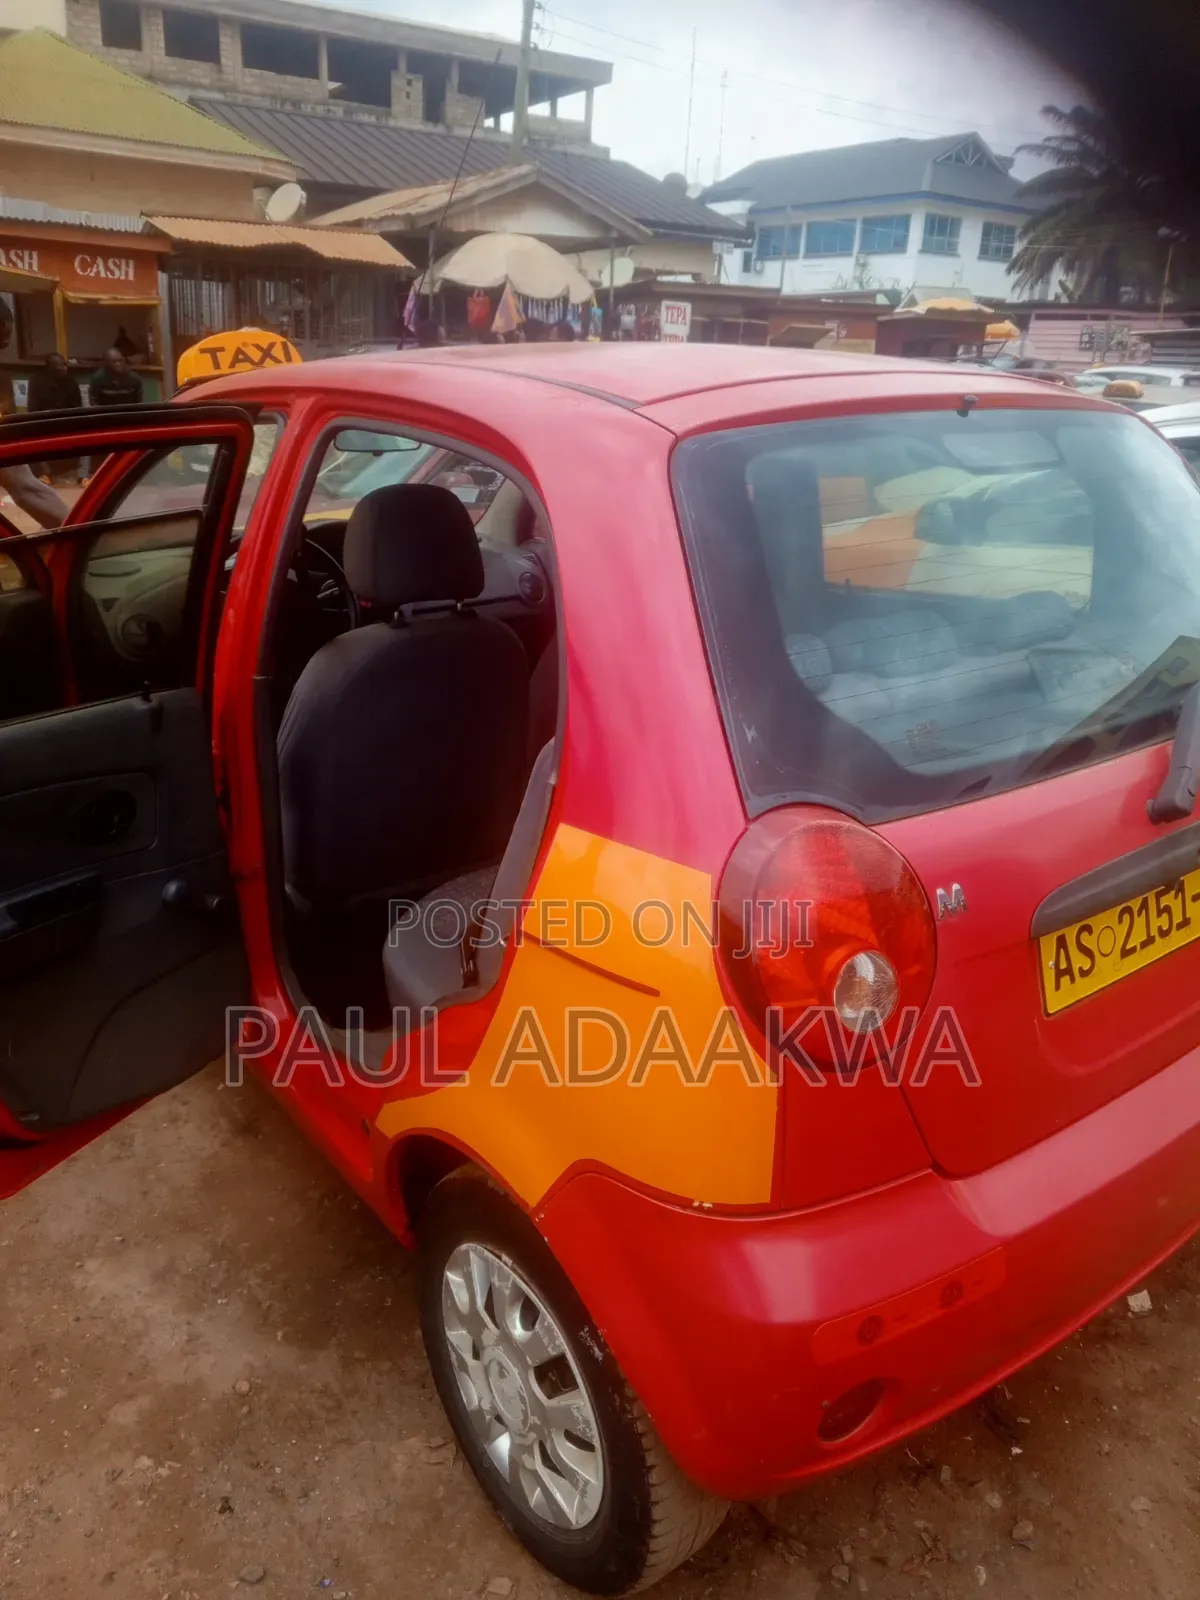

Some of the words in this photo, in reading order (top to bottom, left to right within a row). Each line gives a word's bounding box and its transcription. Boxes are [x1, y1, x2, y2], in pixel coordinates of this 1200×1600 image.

[74, 254, 135, 280] CASH
[665, 306, 688, 326] TEPA
[199, 340, 293, 371] TAXI
[1054, 923, 1096, 992] AS
